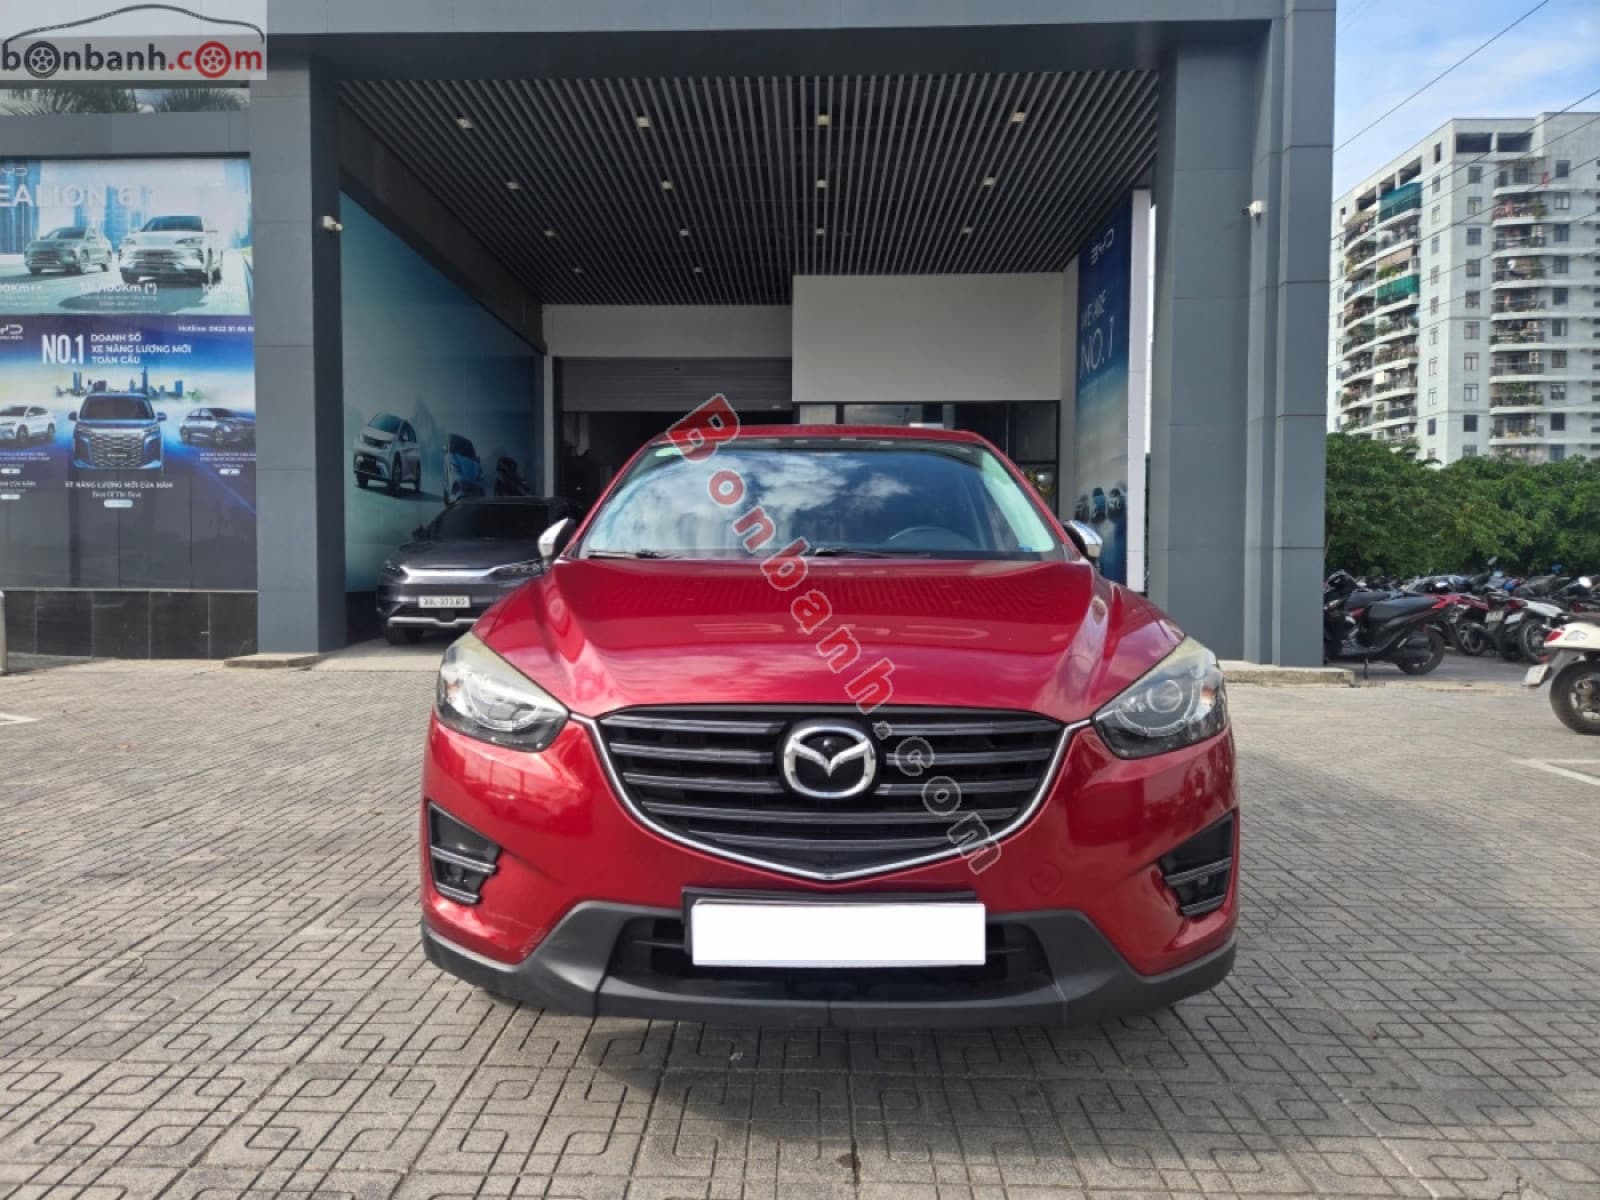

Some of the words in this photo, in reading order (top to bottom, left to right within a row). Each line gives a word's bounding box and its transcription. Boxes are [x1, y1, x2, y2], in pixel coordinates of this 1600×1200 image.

[90, 334, 126, 342] DOANH
[41, 333, 84, 364] NO.1
[91, 344, 104, 353] XE
